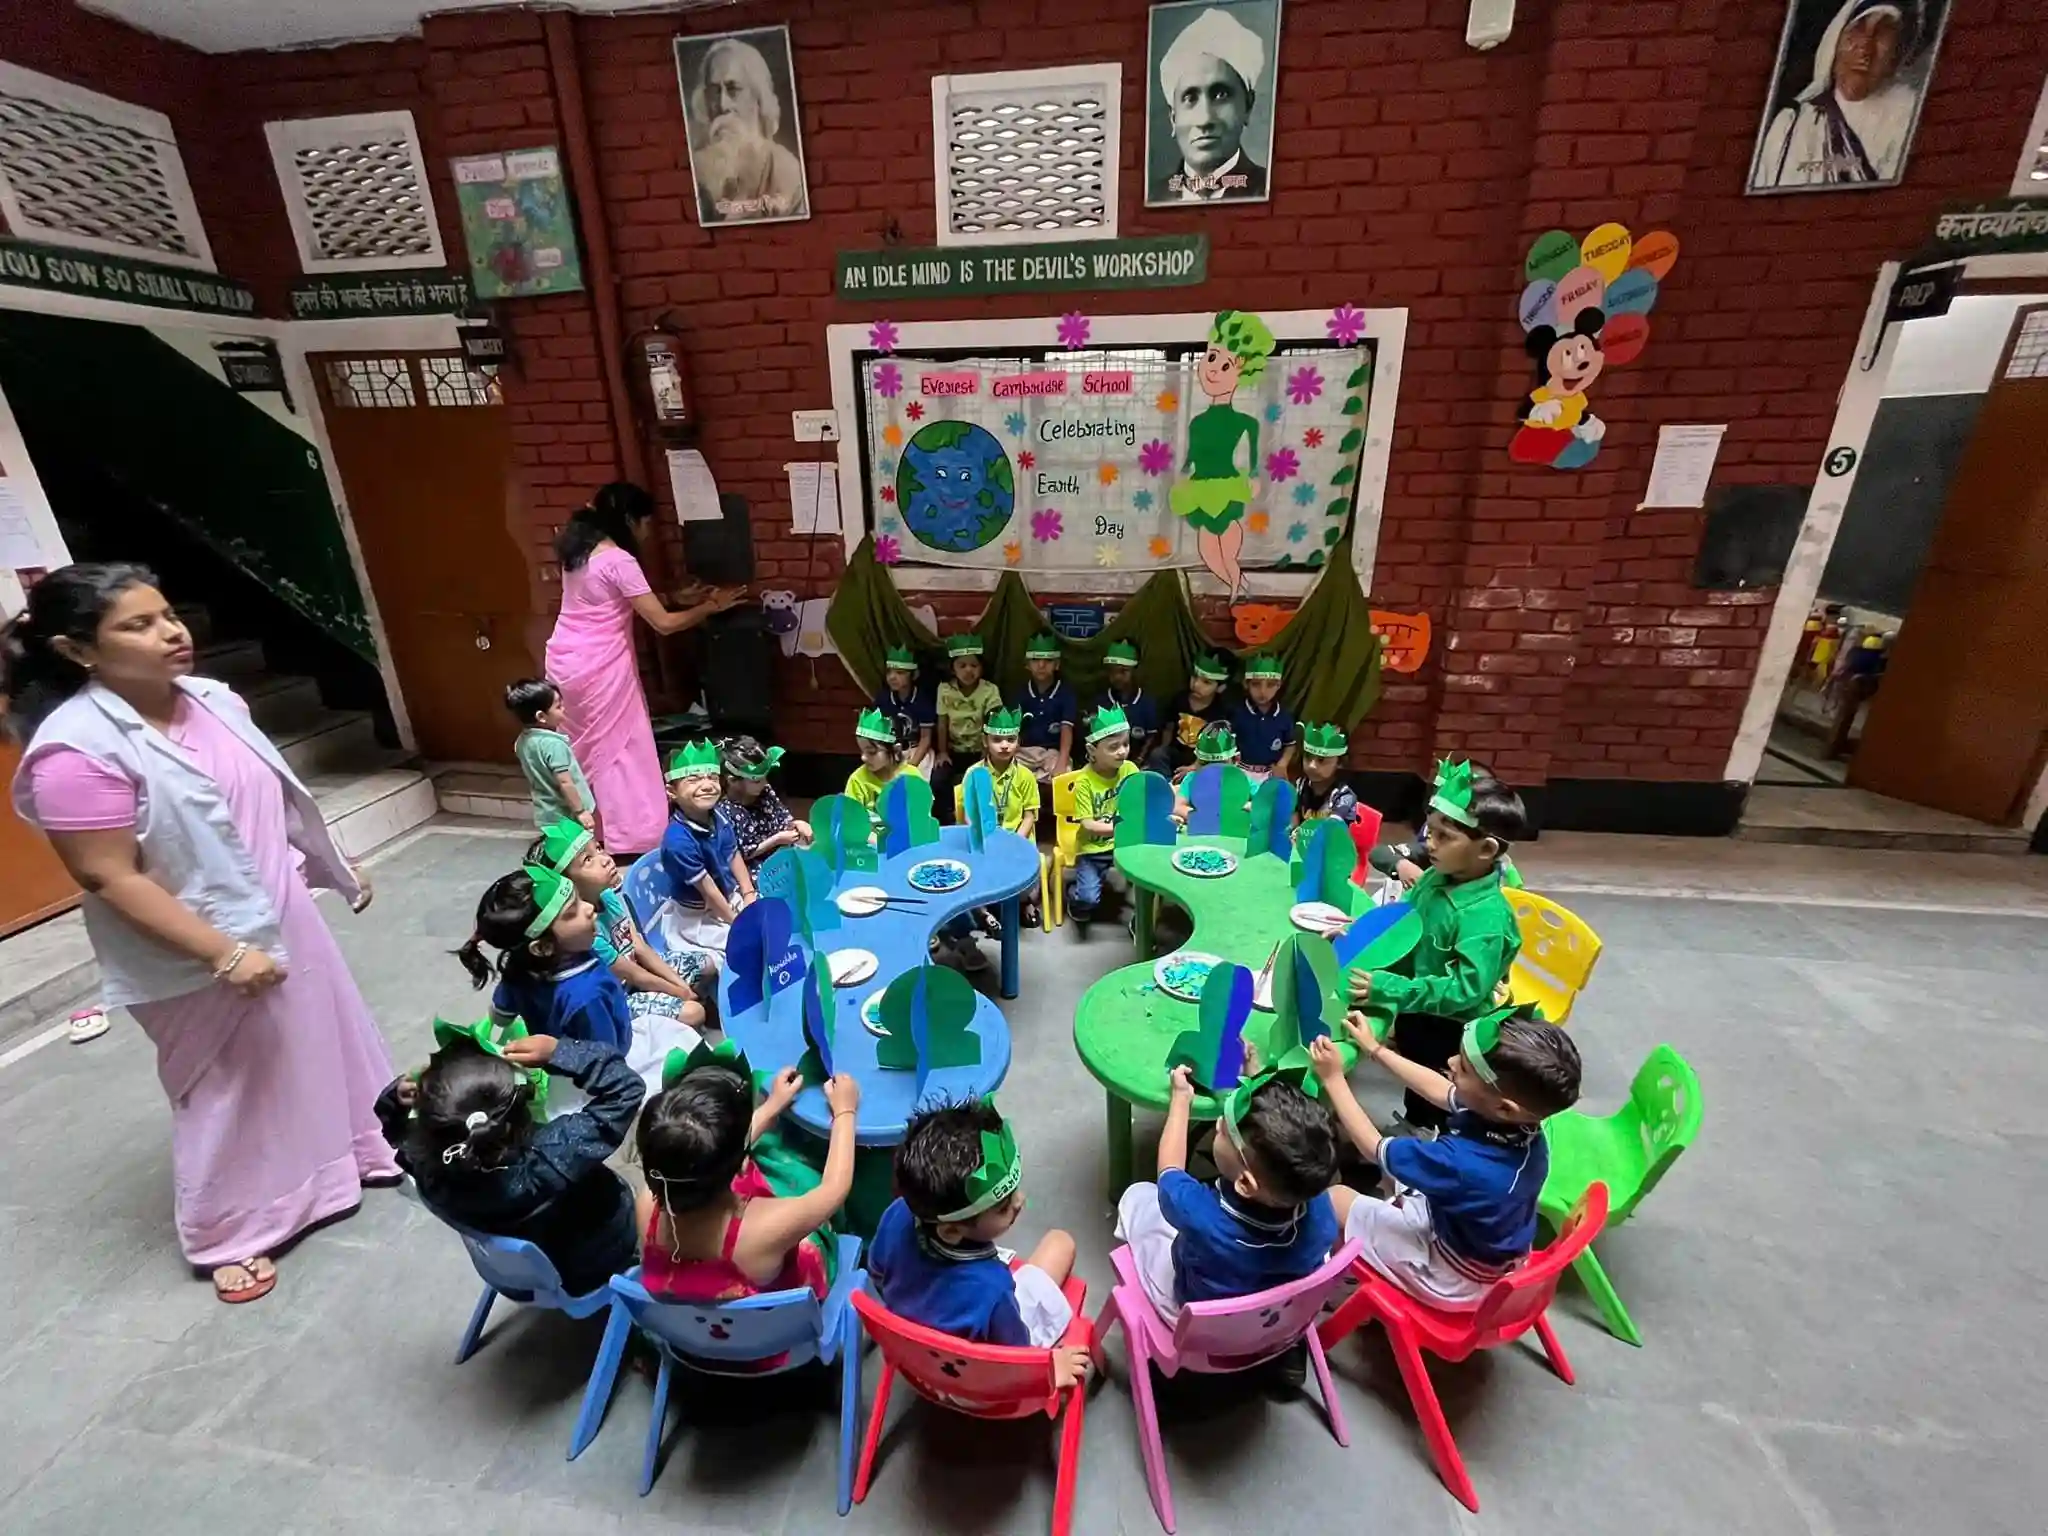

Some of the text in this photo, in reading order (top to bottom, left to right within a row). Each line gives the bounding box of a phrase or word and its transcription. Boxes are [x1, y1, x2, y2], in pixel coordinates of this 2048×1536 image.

[47, 256, 99, 288] SOW
[134, 270, 188, 302] SHALL
[844, 249, 1194, 289] AN IDLE MIND IS THE DEVIL'S WORKSHOP
[1561, 279, 1599, 305] FRIDAY
[921, 374, 1130, 397] Everest Cambridge School
[1040, 418, 1136, 446] Celebrating
[1830, 449, 1851, 475] 5
[1037, 473, 1080, 495] Earth
[1095, 515, 1125, 539] Day
